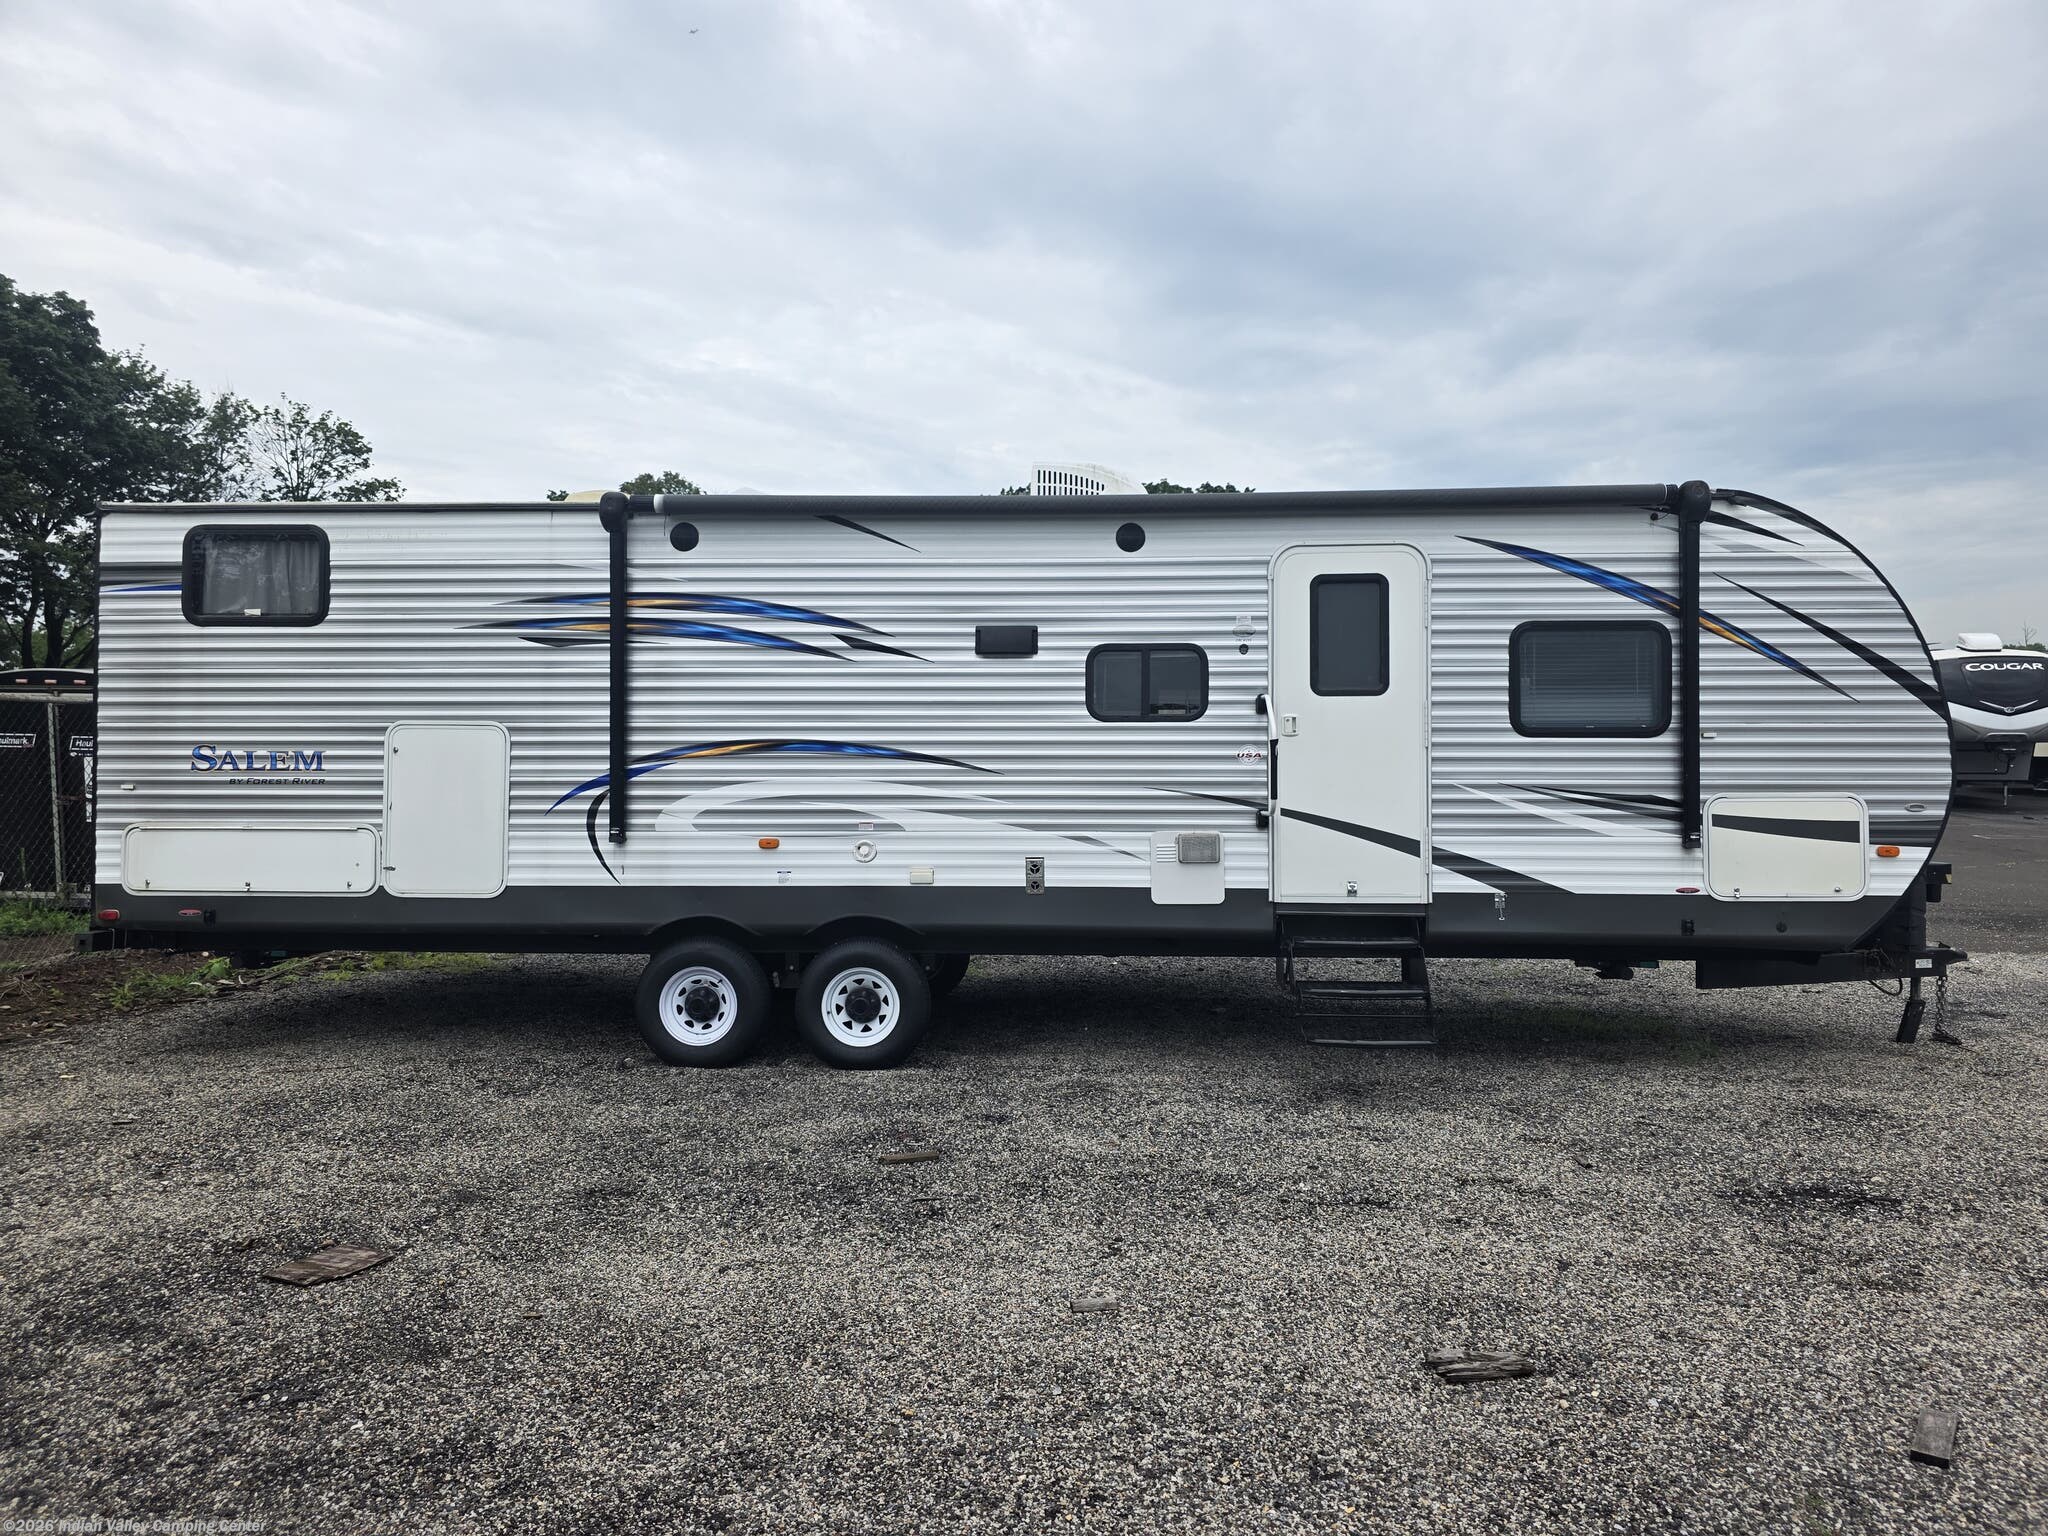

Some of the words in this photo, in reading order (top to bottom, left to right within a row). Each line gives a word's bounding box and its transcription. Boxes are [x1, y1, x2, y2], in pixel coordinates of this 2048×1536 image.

[1965, 662, 2045, 672] COUGAR
[0, 736, 29, 745] ulmark
[75, 739, 94, 747] Haul
[190, 744, 327, 772] SALEM
